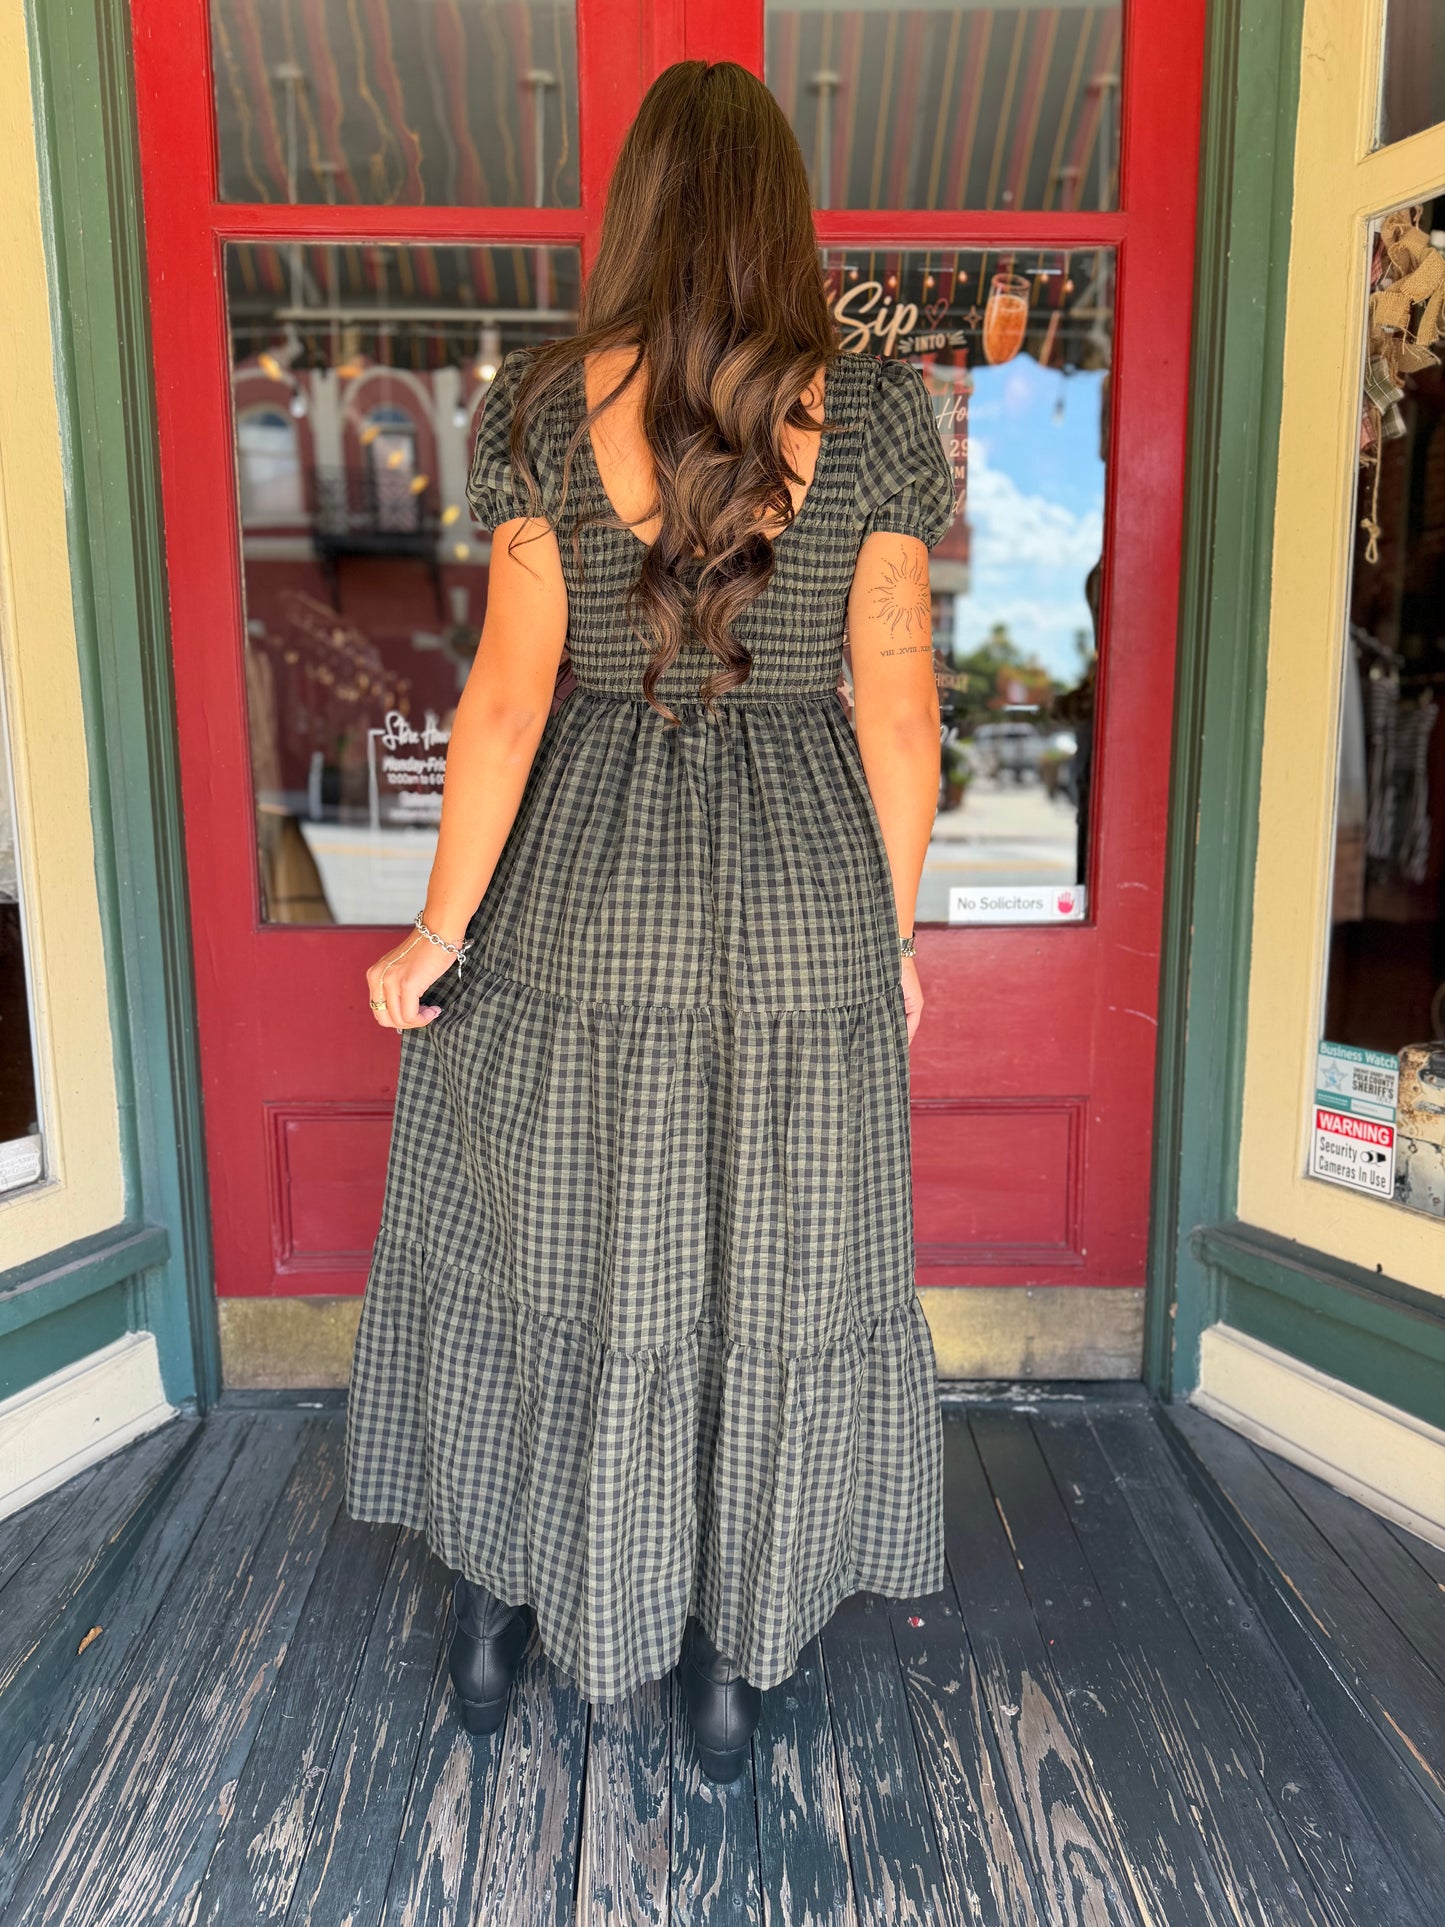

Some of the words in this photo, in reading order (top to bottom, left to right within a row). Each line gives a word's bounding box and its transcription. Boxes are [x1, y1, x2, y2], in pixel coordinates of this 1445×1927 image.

[834, 281, 918, 356] Sip
[914, 333, 946, 352] INTO
[957, 897, 976, 910] No
[980, 896, 1044, 910] Solicitors
[1319, 1042, 1363, 1062] Business
[1364, 1051, 1398, 1069] Watch
[1369, 1076, 1395, 1089] COUNTY
[1319, 1112, 1390, 1145] WARNING
[1320, 1136, 1358, 1163] Security
[1319, 1155, 1356, 1179] Cameras
[1358, 1168, 1367, 1183] In
[1369, 1171, 1386, 1188] Use
